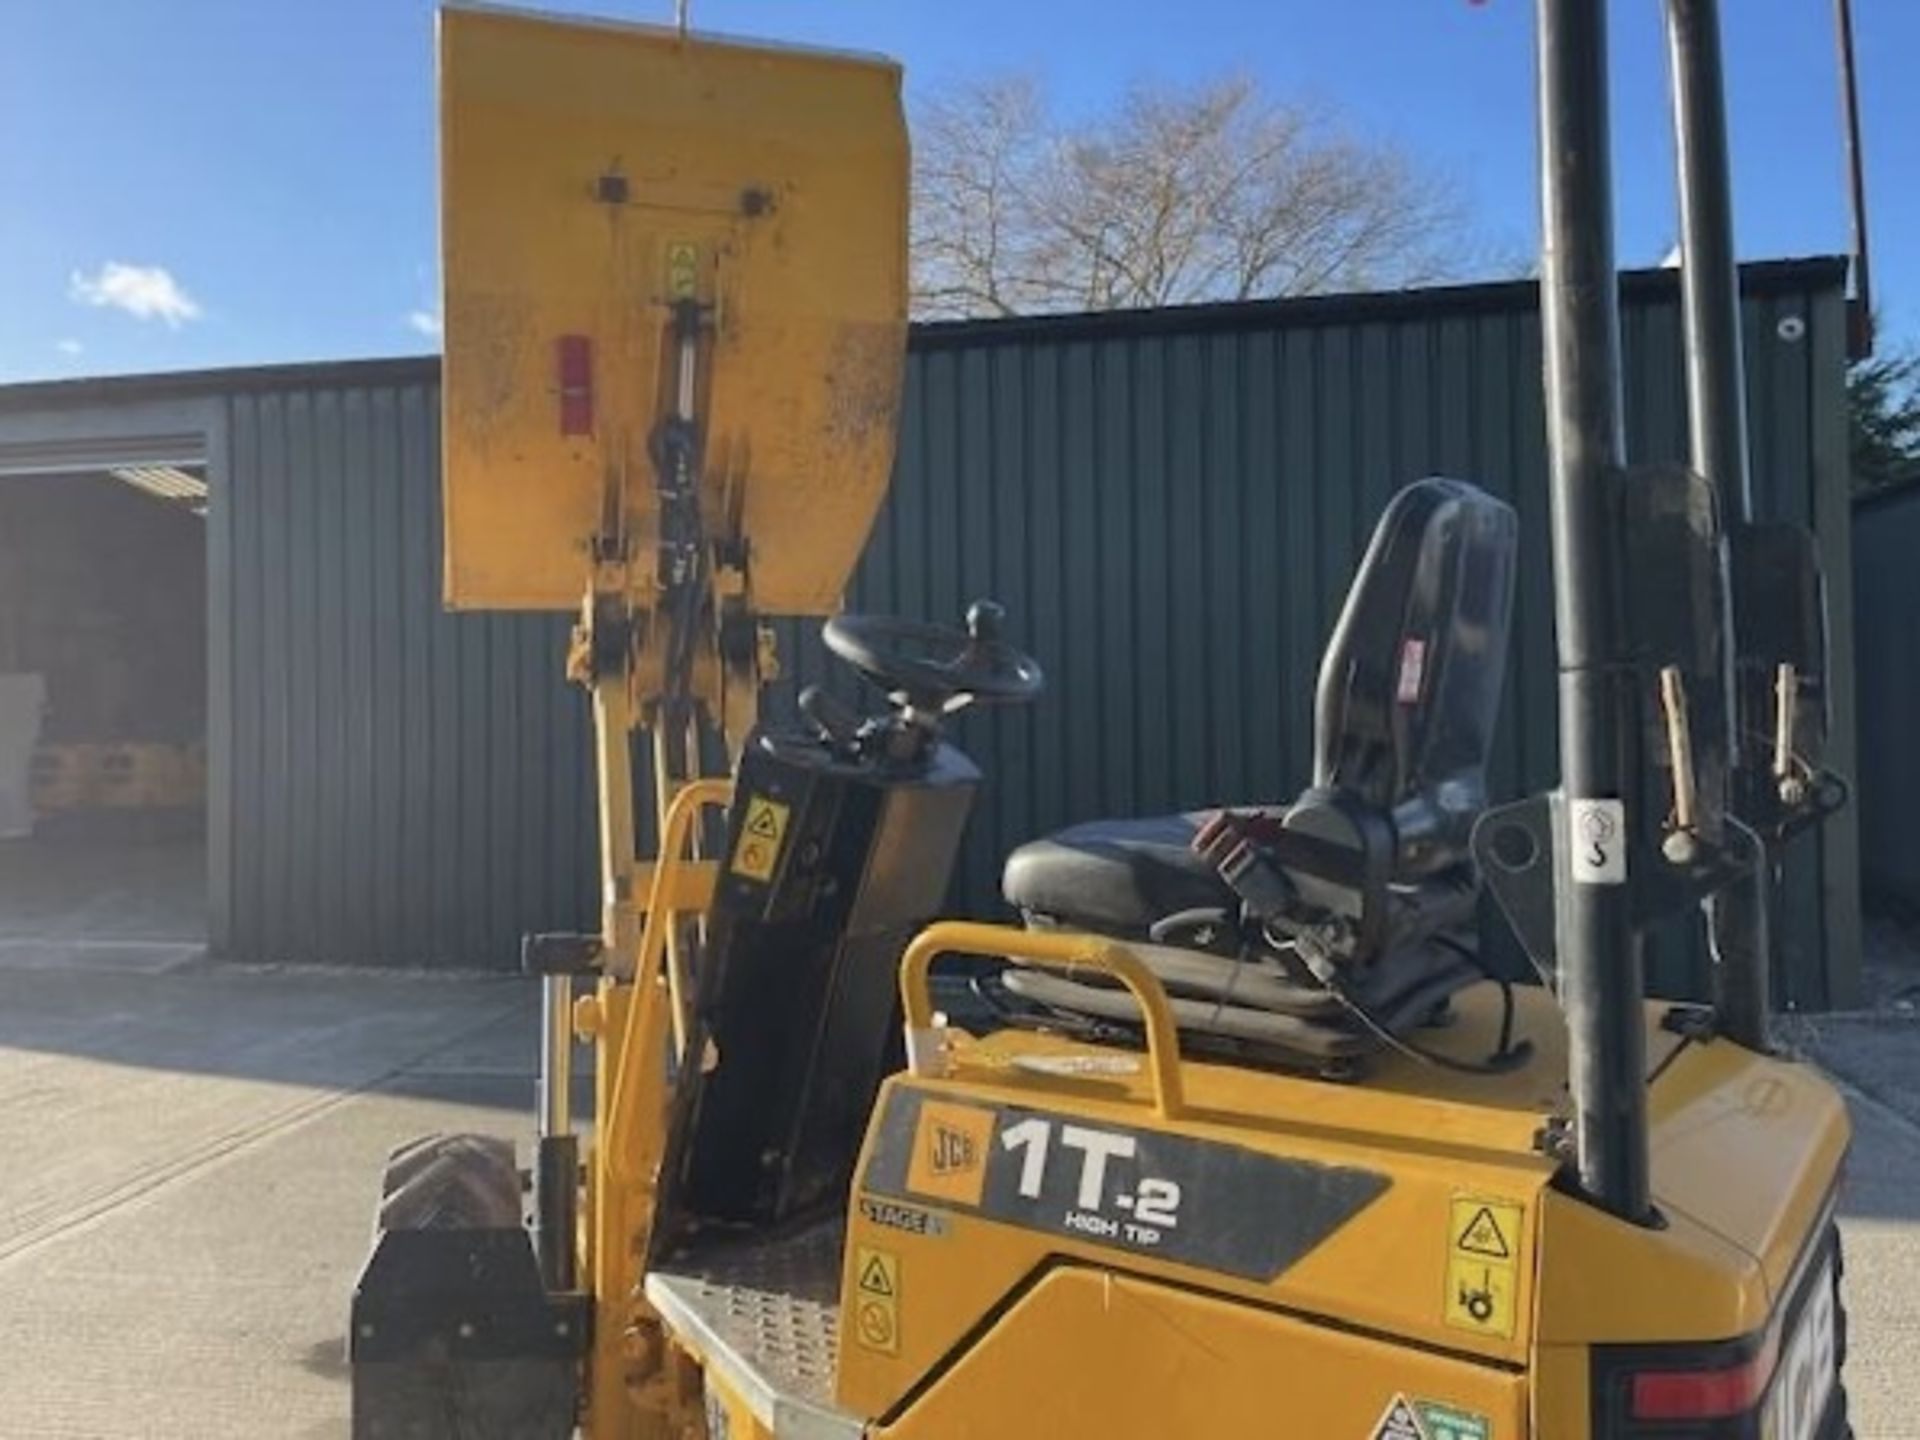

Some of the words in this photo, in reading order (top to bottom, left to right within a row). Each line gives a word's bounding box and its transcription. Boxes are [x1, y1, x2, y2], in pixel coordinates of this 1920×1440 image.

[933, 1126, 981, 1171] JCB
[860, 1199, 928, 1235] STAGE
[1064, 1211, 1119, 1237] HIGH
[1123, 1223, 1160, 1245] TIP
